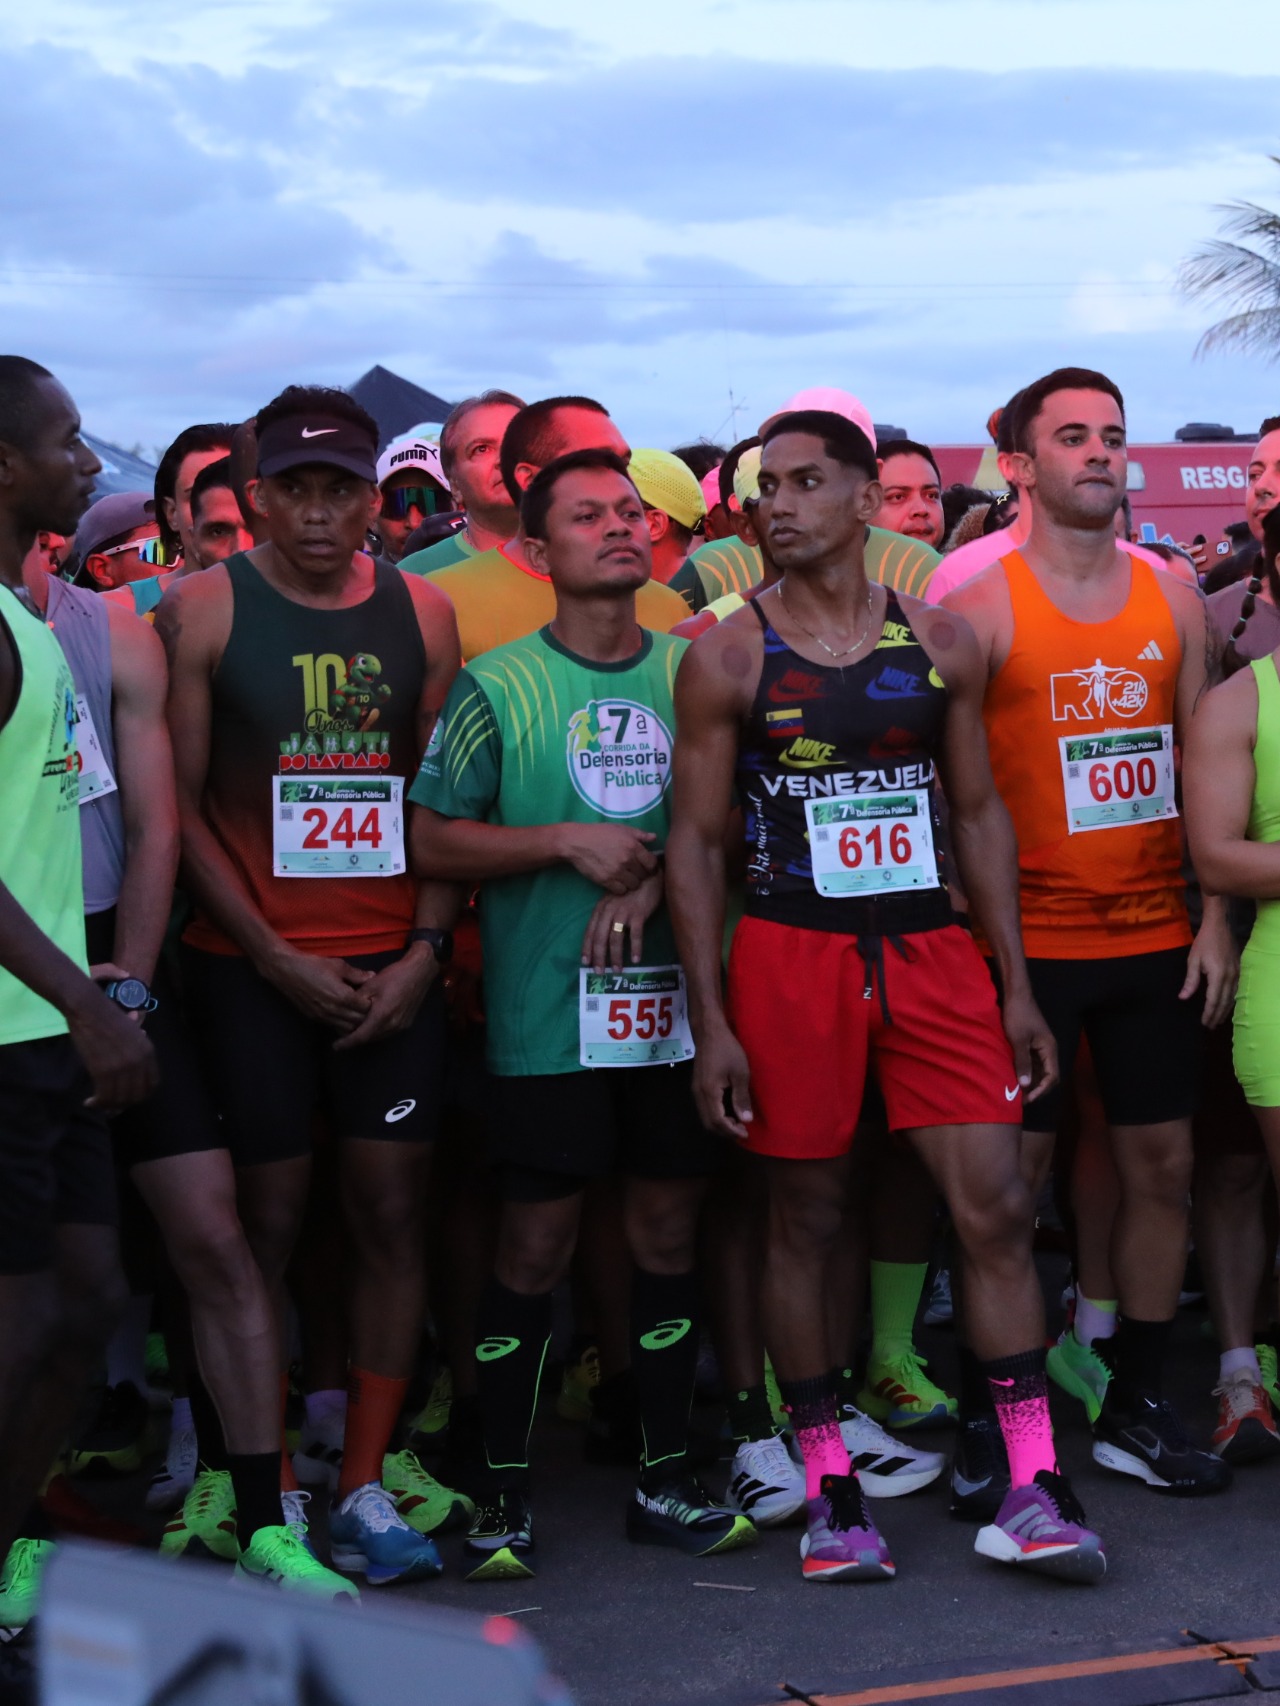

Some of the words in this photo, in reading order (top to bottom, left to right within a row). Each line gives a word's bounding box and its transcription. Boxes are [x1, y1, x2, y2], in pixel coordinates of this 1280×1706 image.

[390, 449, 427, 467] PUMA
[1180, 466, 1249, 490] RESG
[292, 653, 347, 727] 10
[608, 708, 648, 743] 7ª
[580, 748, 667, 769] Defensoria
[604, 744, 637, 752] CORRIDA
[639, 743, 650, 751] DA
[789, 737, 836, 764] NIKE
[1105, 743, 1138, 754] Defensoria
[1138, 741, 1158, 750] Pública
[279, 754, 307, 771] DO
[308, 752, 391, 769] LAVRADO
[604, 769, 663, 788] Pública
[1089, 757, 1156, 803] 600
[325, 789, 361, 799] Defensoria
[362, 789, 386, 799] Pública
[856, 806, 891, 818] Defensoria
[891, 805, 913, 815] Pública
[302, 807, 383, 849] 244
[838, 822, 912, 869] 616
[607, 996, 673, 1041] 555
